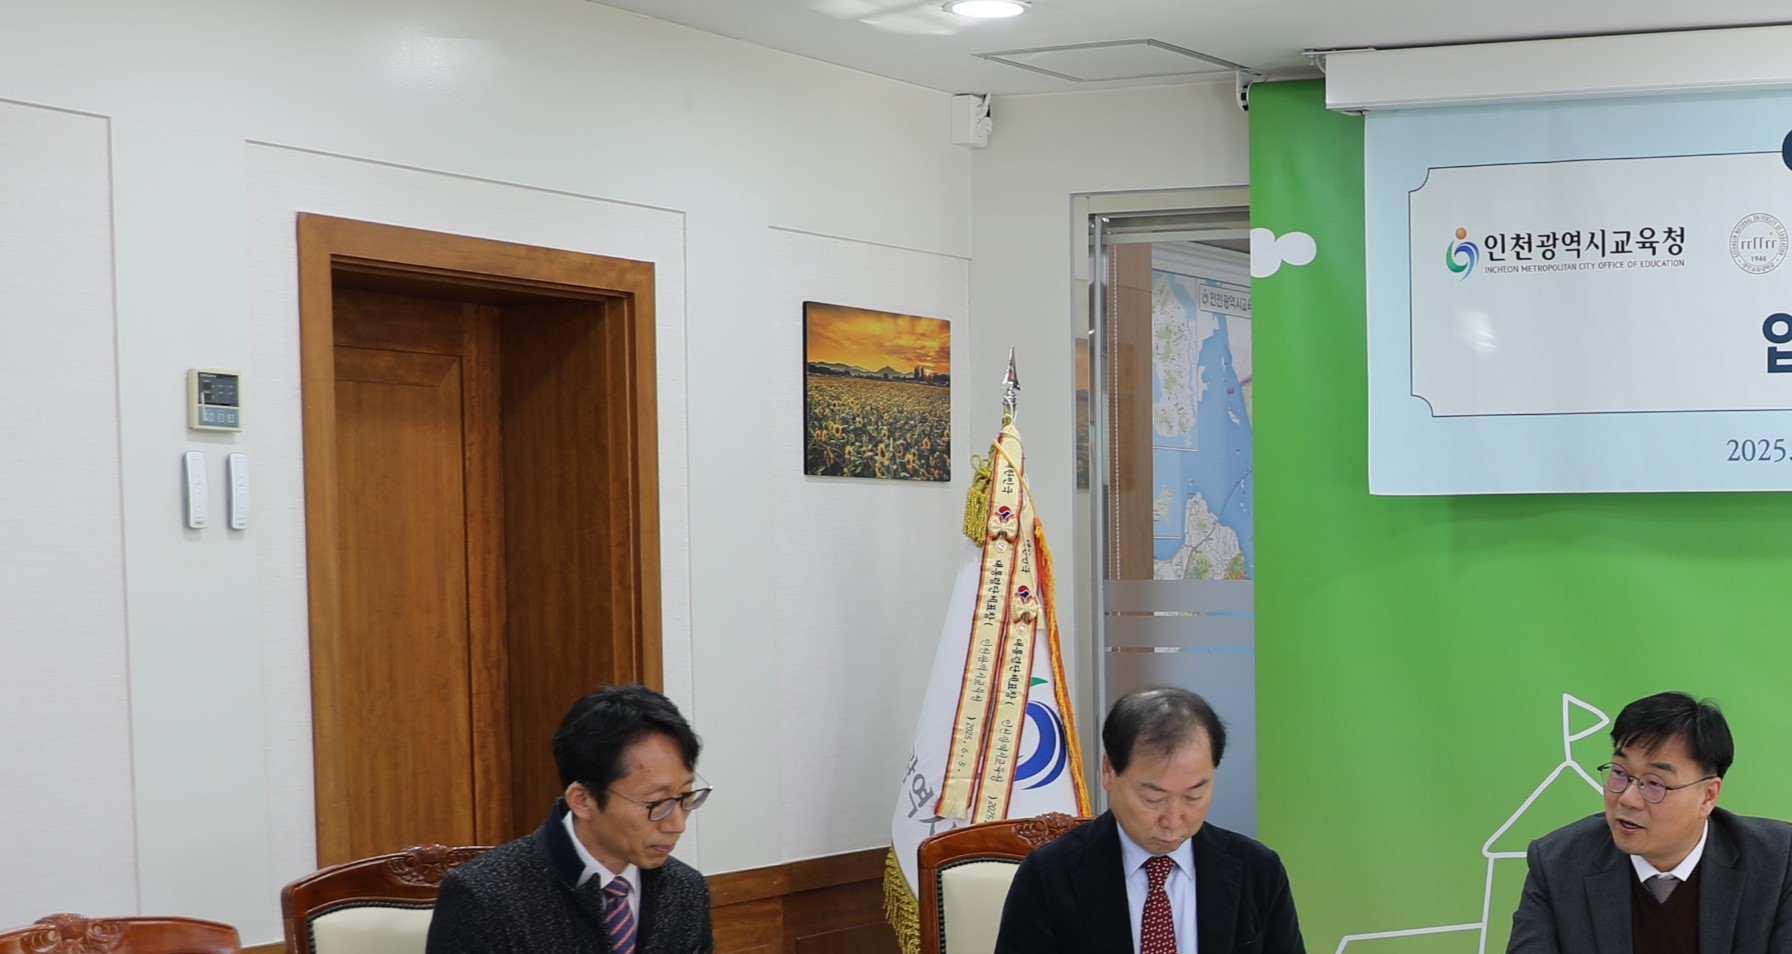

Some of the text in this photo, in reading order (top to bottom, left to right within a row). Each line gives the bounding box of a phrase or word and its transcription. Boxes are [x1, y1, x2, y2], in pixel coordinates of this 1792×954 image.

[1484, 226, 1685, 262] 인천광역시교육청
[1484, 259, 1685, 274] INCHEON METROPOLITAN CITY OFFICE OF EDUCATION
